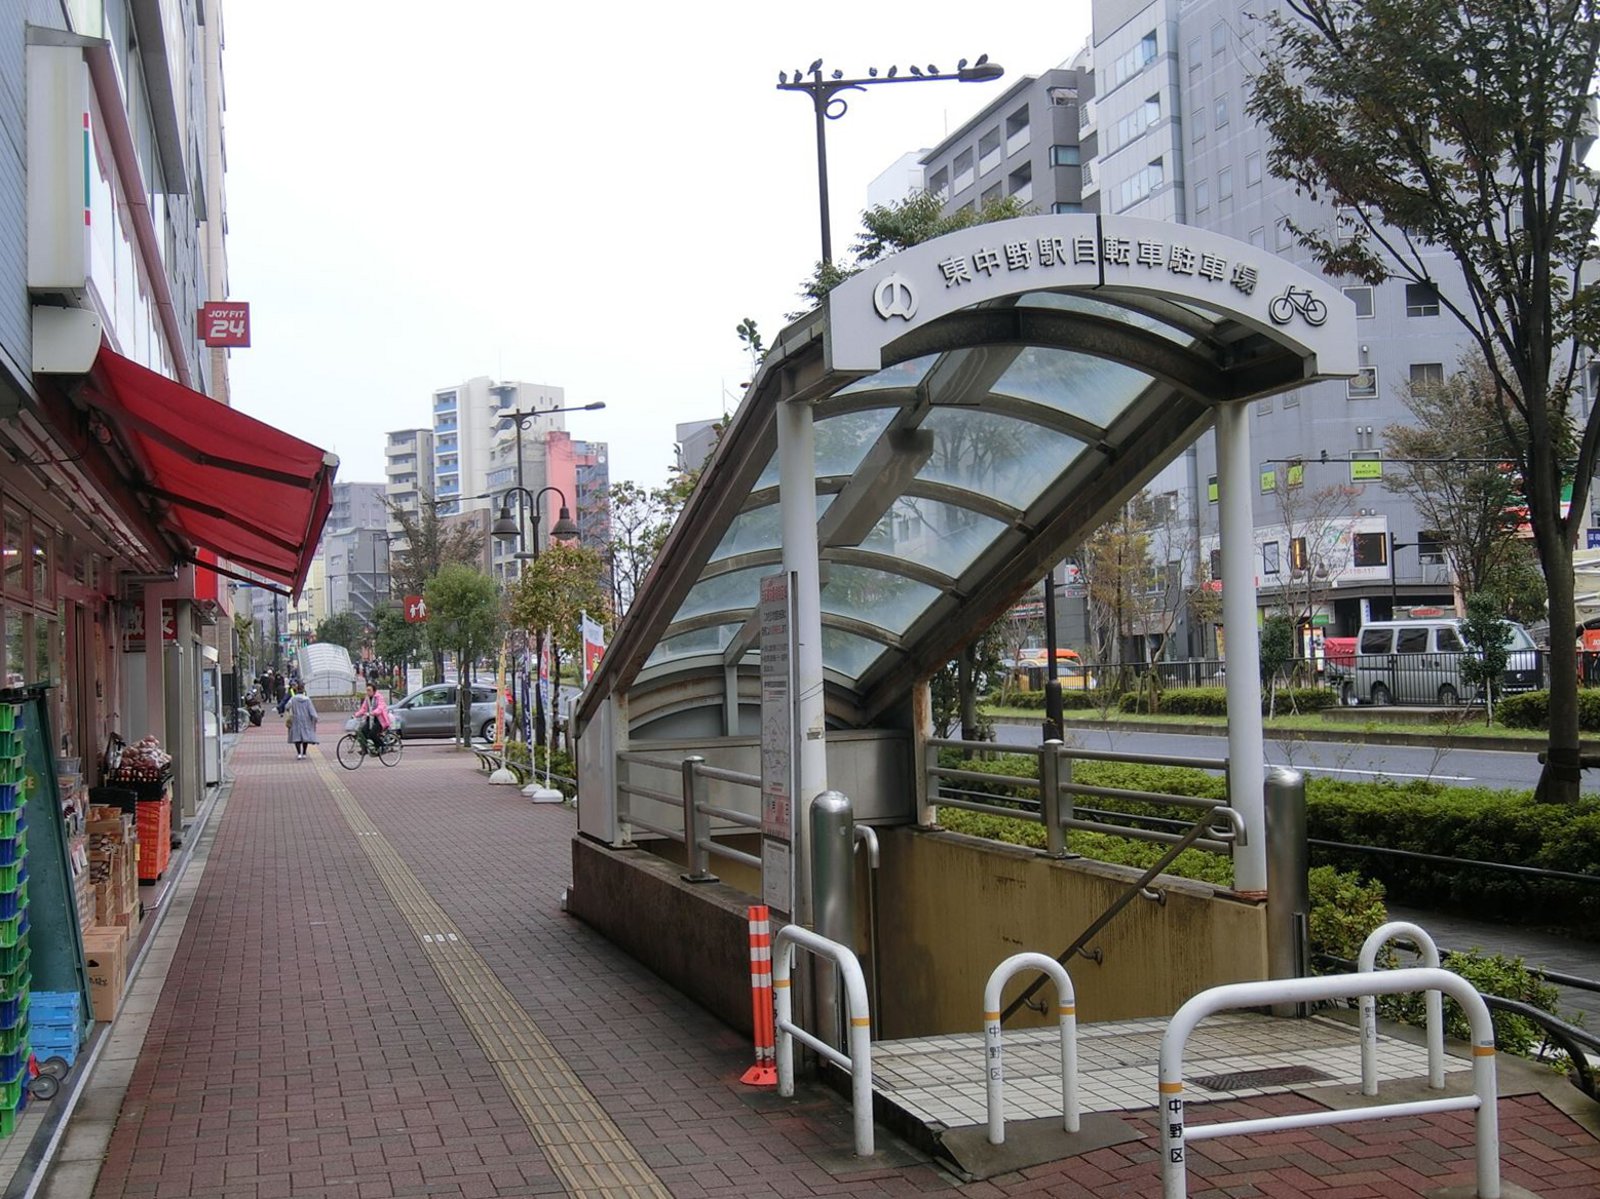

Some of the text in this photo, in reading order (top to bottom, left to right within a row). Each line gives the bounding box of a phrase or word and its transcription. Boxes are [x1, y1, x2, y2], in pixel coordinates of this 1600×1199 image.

[938, 234, 1260, 296] 東中野駅自転車駐車場
[210, 320, 245, 338] 24
[988, 1024, 1001, 1081] 中野区
[1168, 1098, 1184, 1163] 中野区
